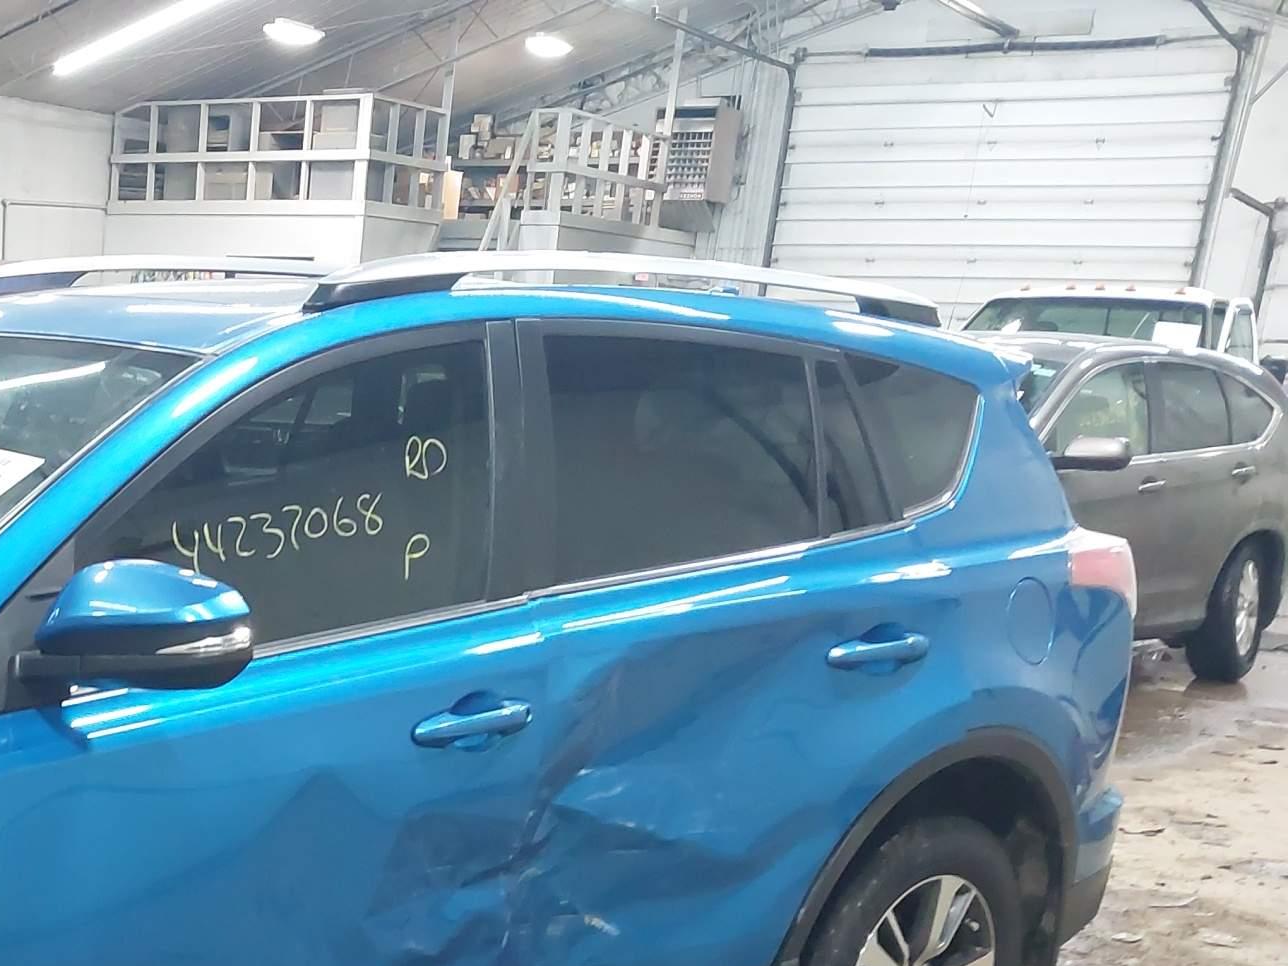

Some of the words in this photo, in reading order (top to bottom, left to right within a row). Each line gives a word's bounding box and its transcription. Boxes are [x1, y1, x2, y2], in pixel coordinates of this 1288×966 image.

[404, 435, 448, 480] RD
[171, 492, 384, 575] 44237068
[404, 533, 431, 580] P
